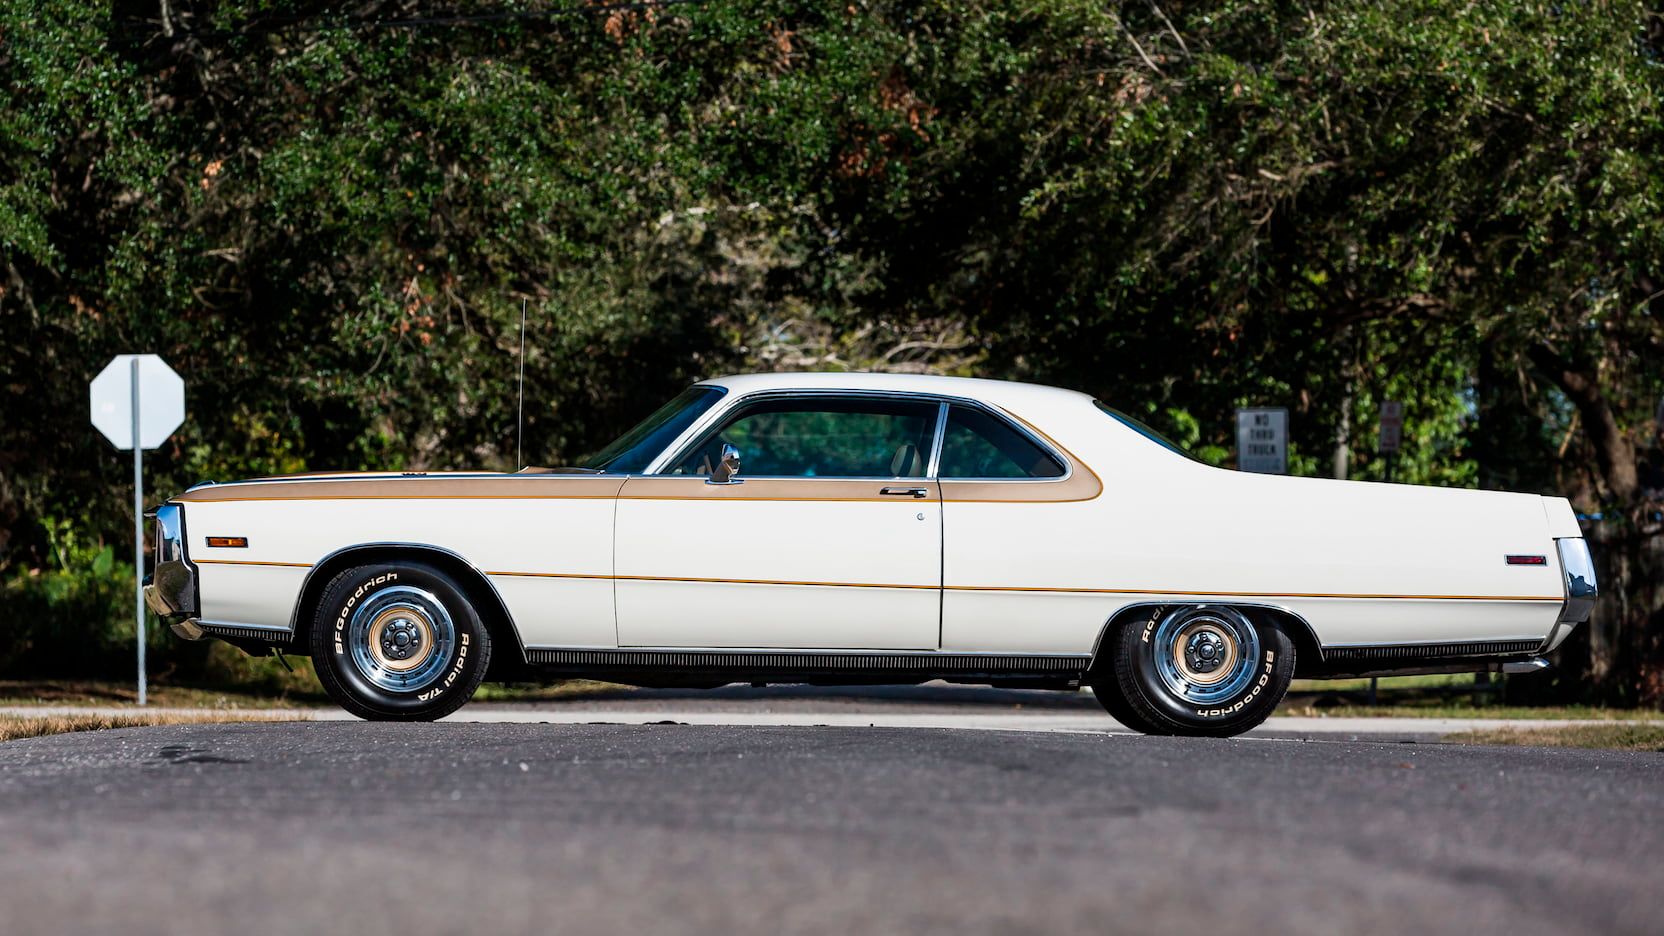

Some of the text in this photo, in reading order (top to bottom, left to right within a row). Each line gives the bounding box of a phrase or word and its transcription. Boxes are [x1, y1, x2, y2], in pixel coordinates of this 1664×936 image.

[1255, 414, 1269, 426] NO
[335, 572, 398, 655] BFGoodrich
[1141, 604, 1168, 643] Radi
[418, 633, 470, 701] Radial T/A
[1197, 650, 1274, 717] BFGoodrich
